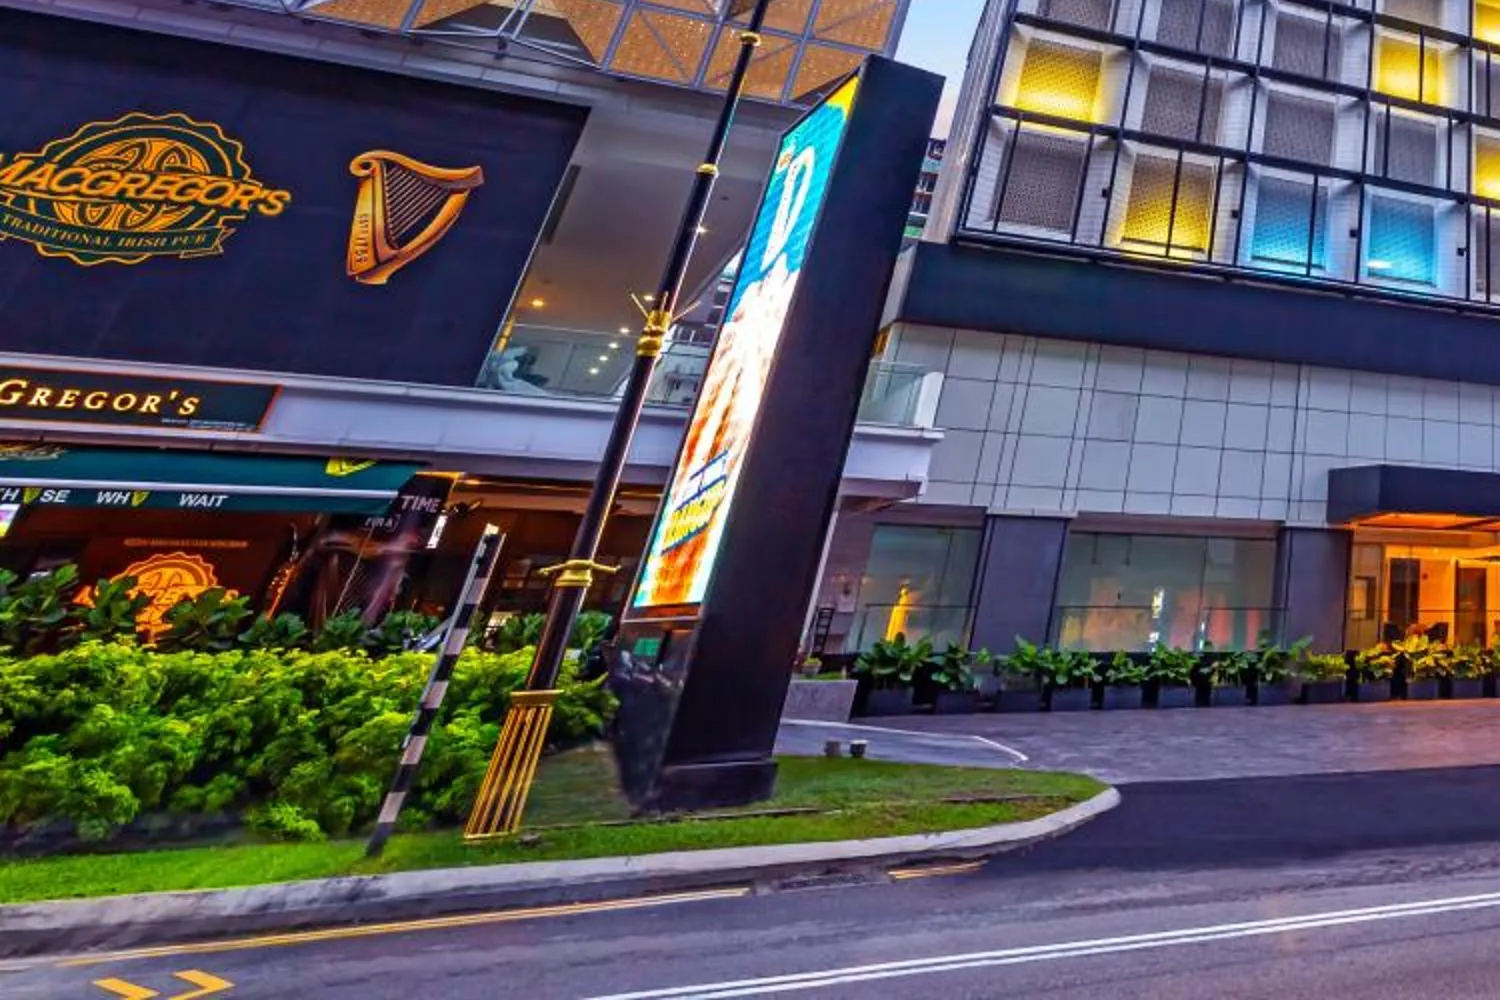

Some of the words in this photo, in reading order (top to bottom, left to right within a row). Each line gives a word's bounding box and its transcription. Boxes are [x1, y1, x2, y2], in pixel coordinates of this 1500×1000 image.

[3, 213, 113, 248] TRADITIONAL
[117, 236, 168, 248] IRISH
[171, 233, 207, 247] PUB
[0, 379, 201, 416] GREGOR'S
[178, 493, 228, 508] WAIT
[401, 495, 441, 514] TIME
